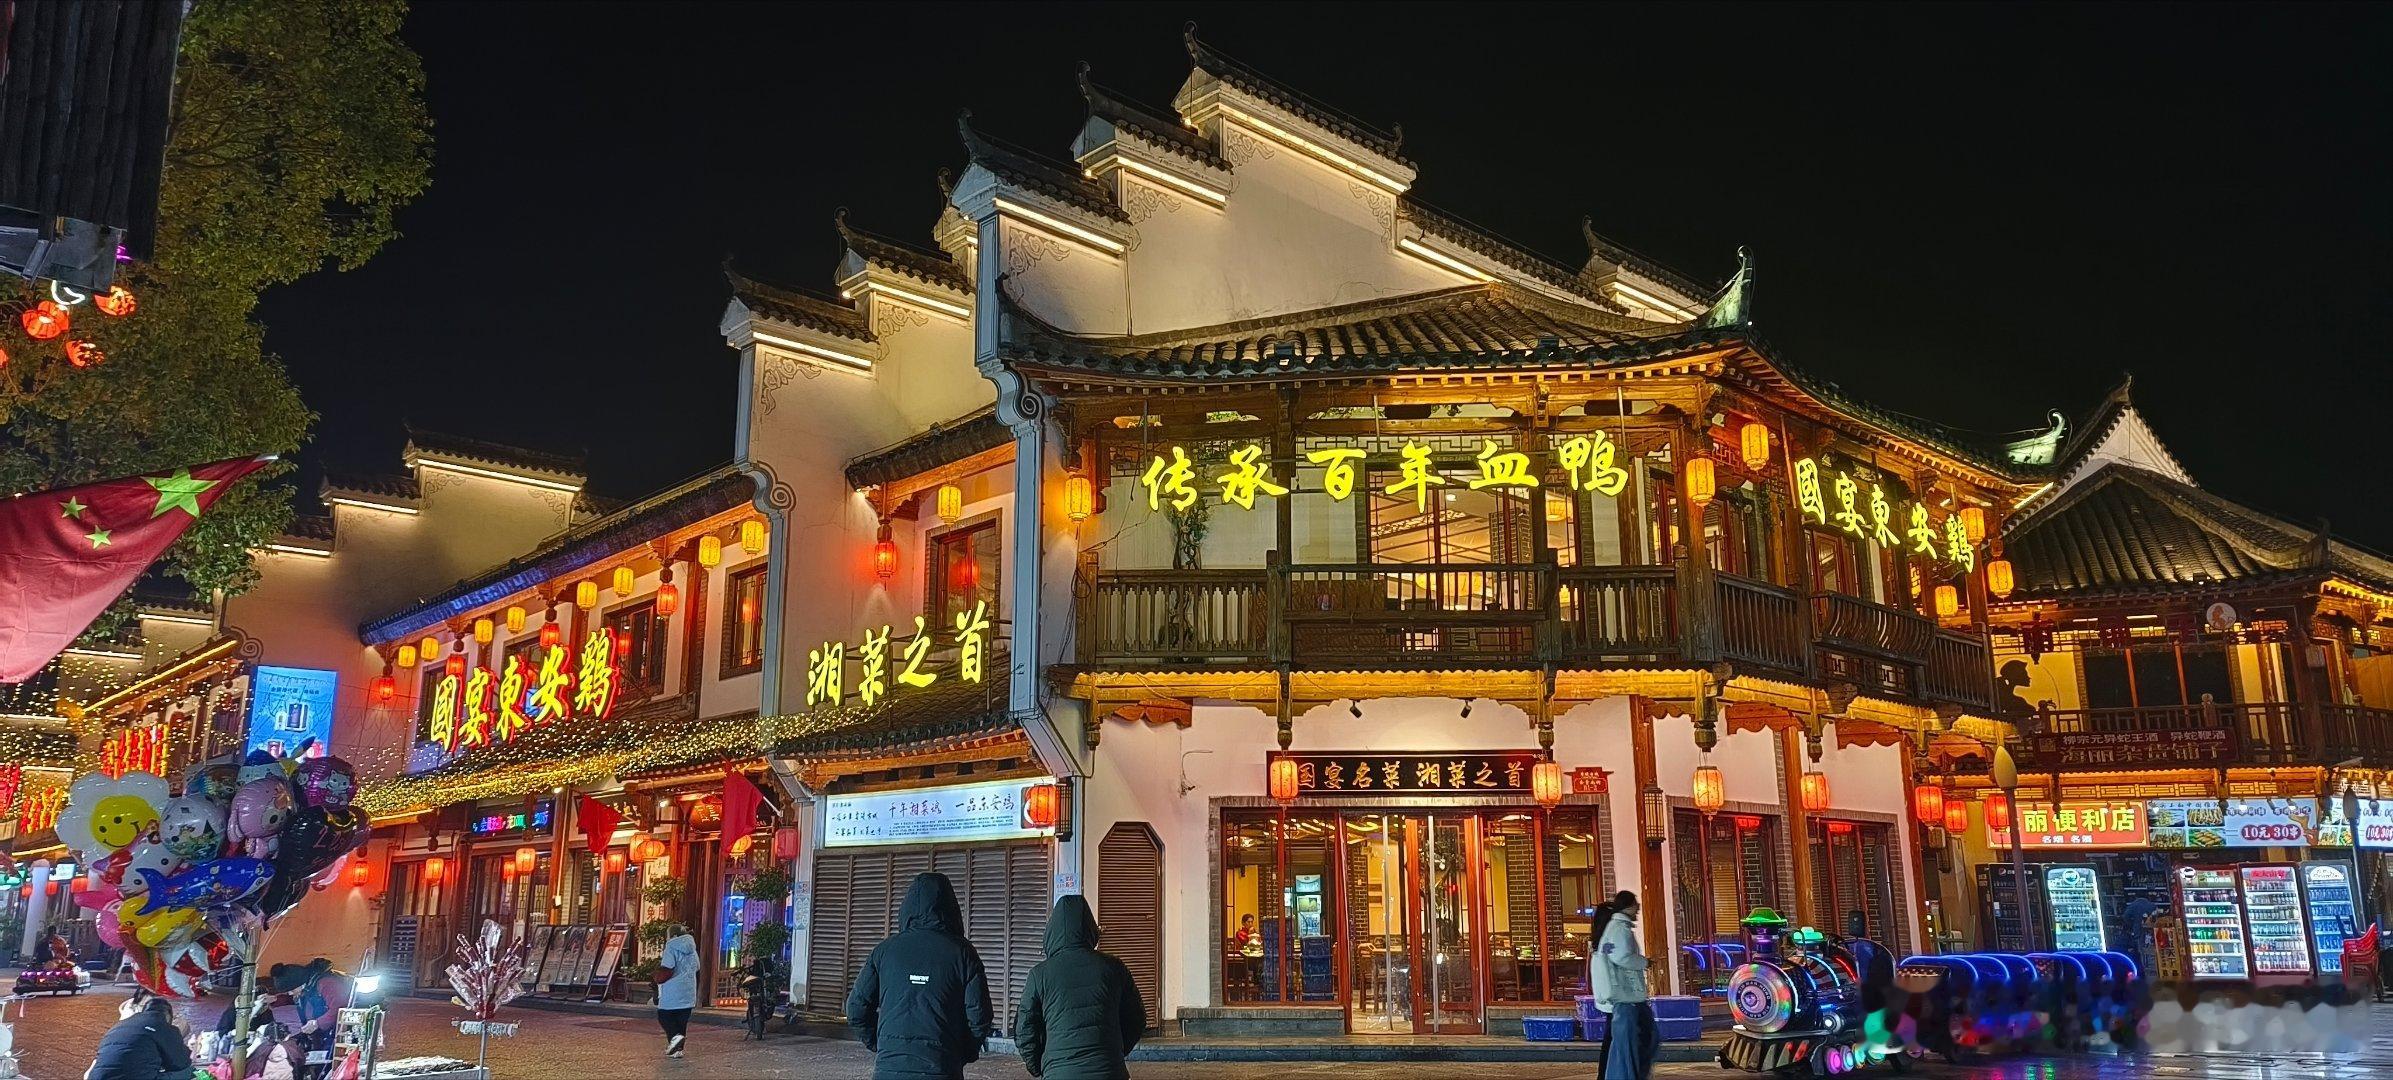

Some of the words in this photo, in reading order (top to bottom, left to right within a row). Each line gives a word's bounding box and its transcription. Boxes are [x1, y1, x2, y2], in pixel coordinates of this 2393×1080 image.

[1141, 430, 1629, 513] 传承百年血鸭
[807, 600, 990, 706] 湘菜之首
[2062, 732, 2159, 746] 柳宗元异蛇王酒
[2170, 729, 2226, 741] 异蛇鞭酒
[1298, 760, 1400, 790] 国宴名菜
[1416, 760, 1525, 790] 湘菜之首
[2006, 807, 2136, 833] 丽便利店
[2243, 825, 2270, 838] 10元
[2273, 824, 2299, 837] 30串
